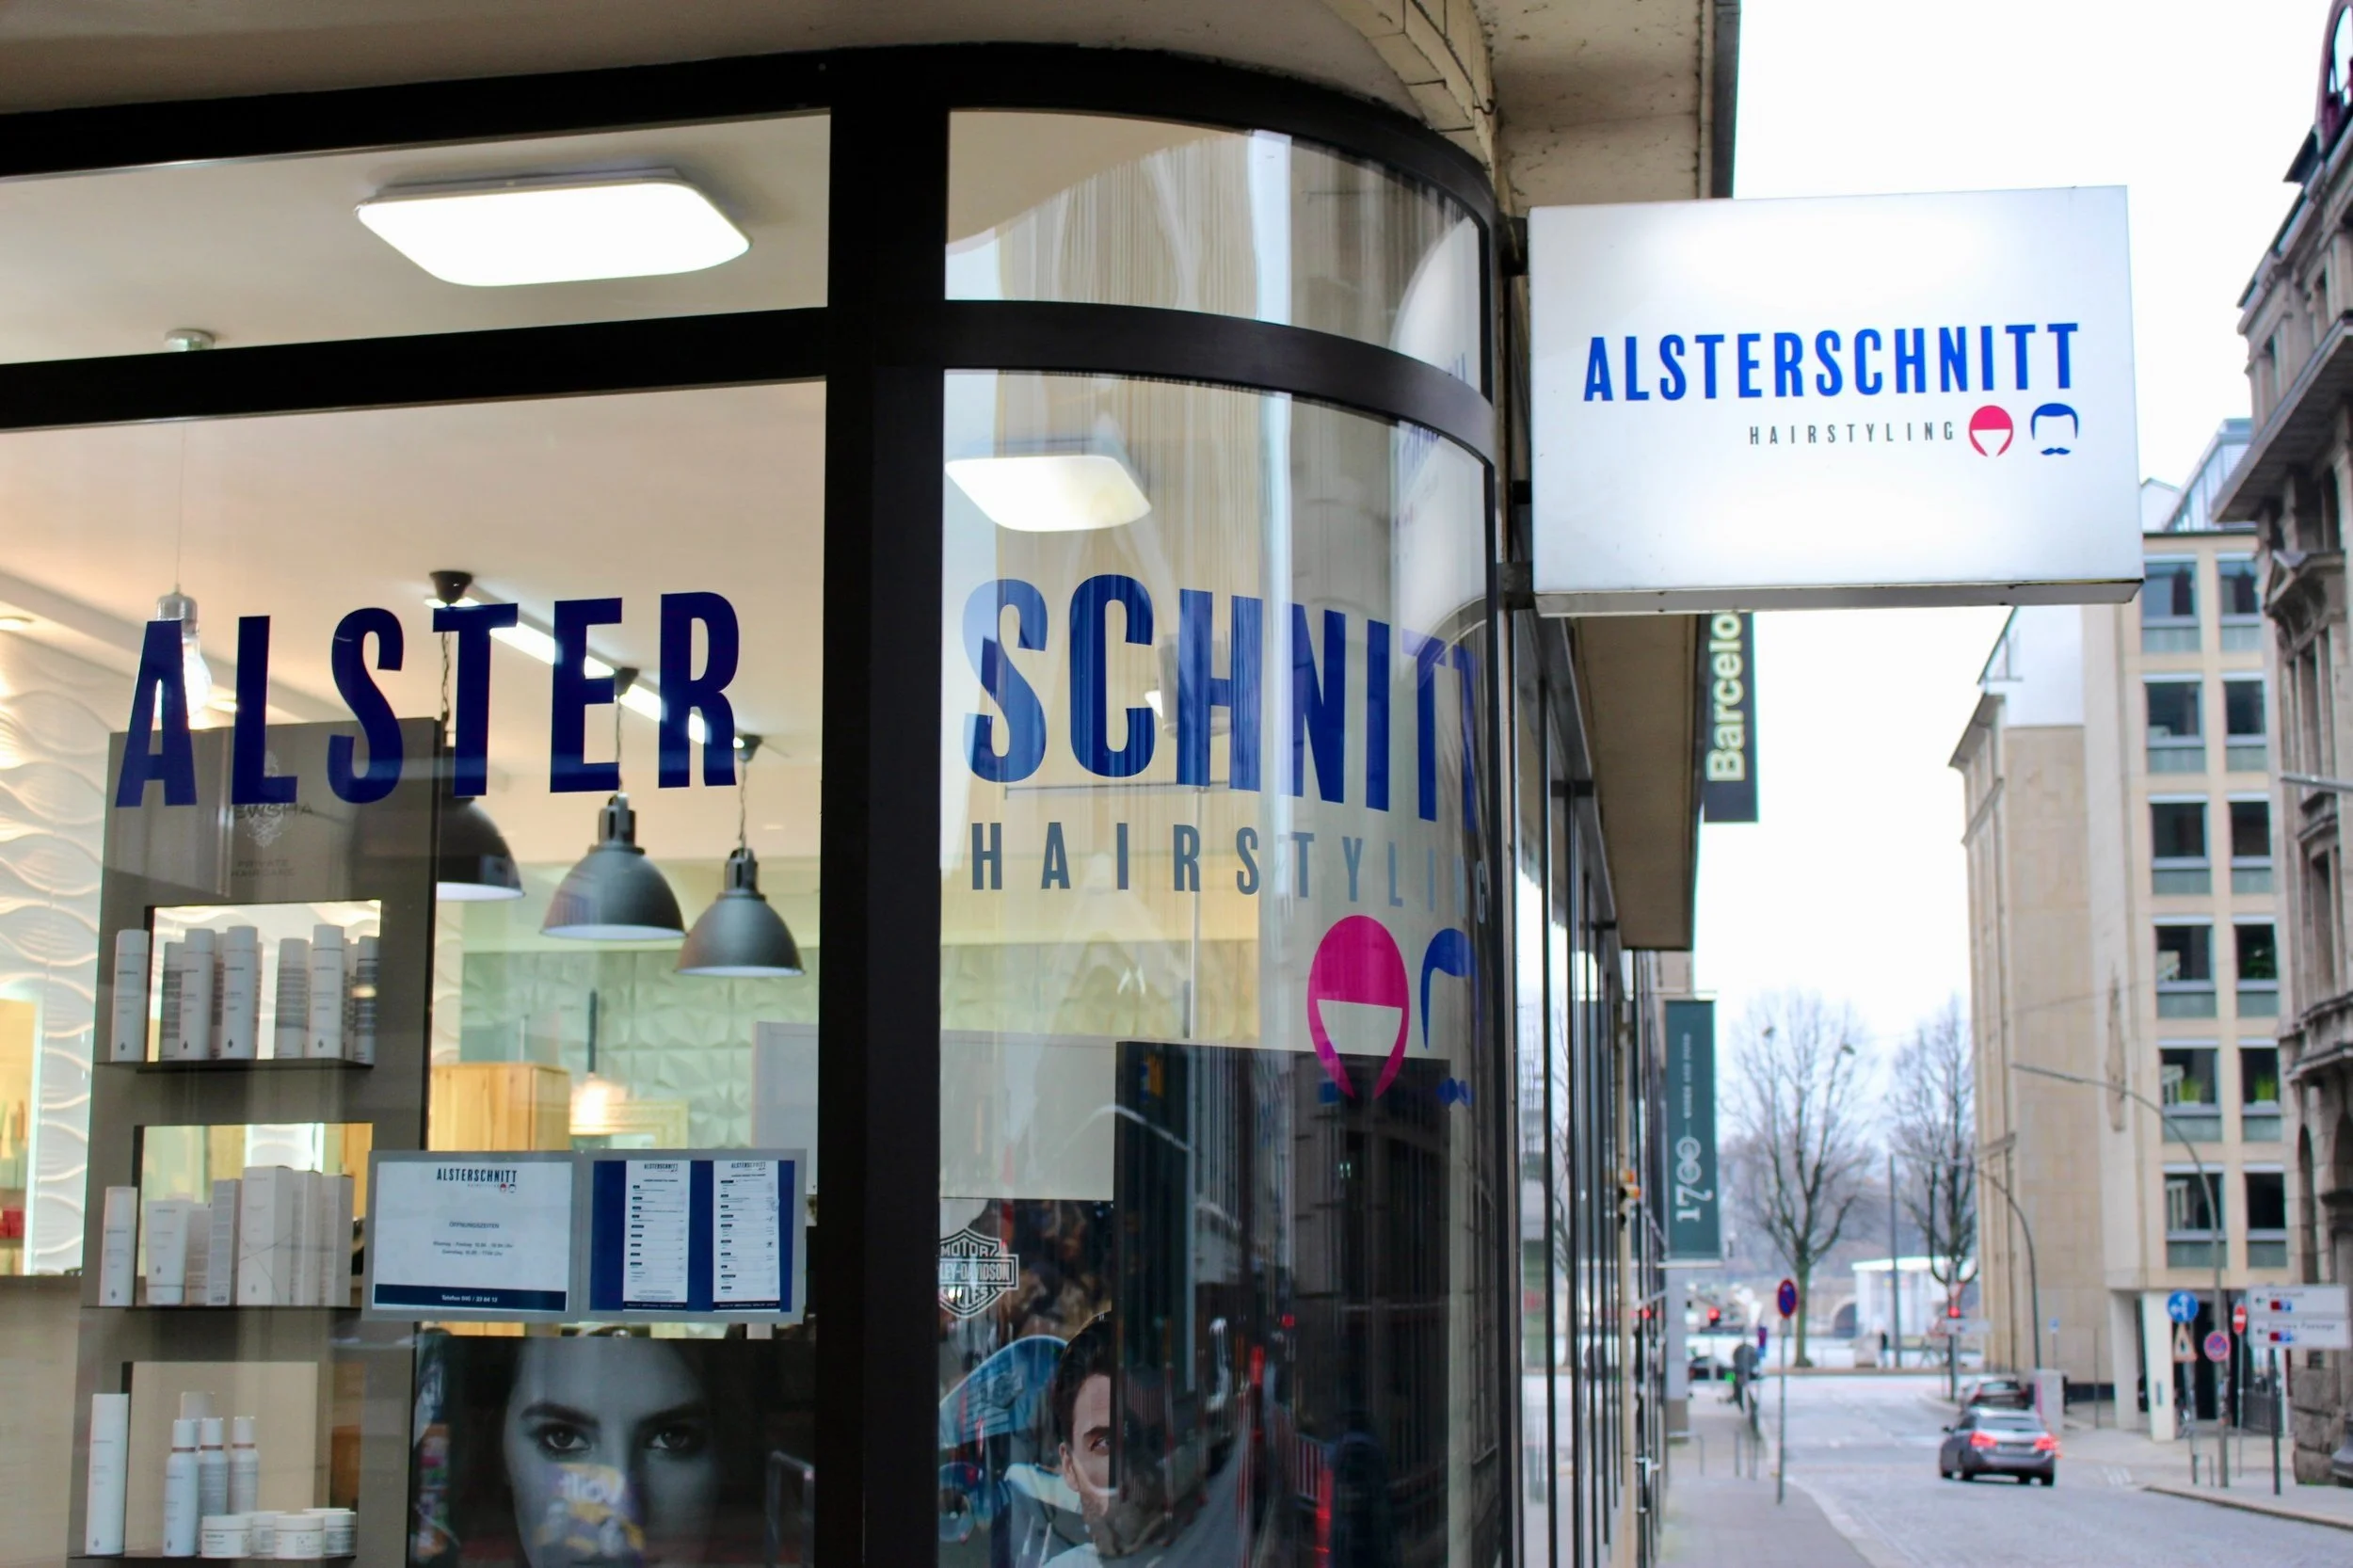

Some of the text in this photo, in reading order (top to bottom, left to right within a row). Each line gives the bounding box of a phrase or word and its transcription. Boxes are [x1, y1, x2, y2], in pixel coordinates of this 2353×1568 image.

[1583, 322, 2079, 403] ALSTERSCHNITT
[1749, 421, 1954, 446] HAIRSTYLING
[116, 573, 1482, 833] ALSTER SCHNITT
[1706, 612, 1746, 782] Barcelo
[437, 1167, 518, 1183] ALSTERSCHNITT
